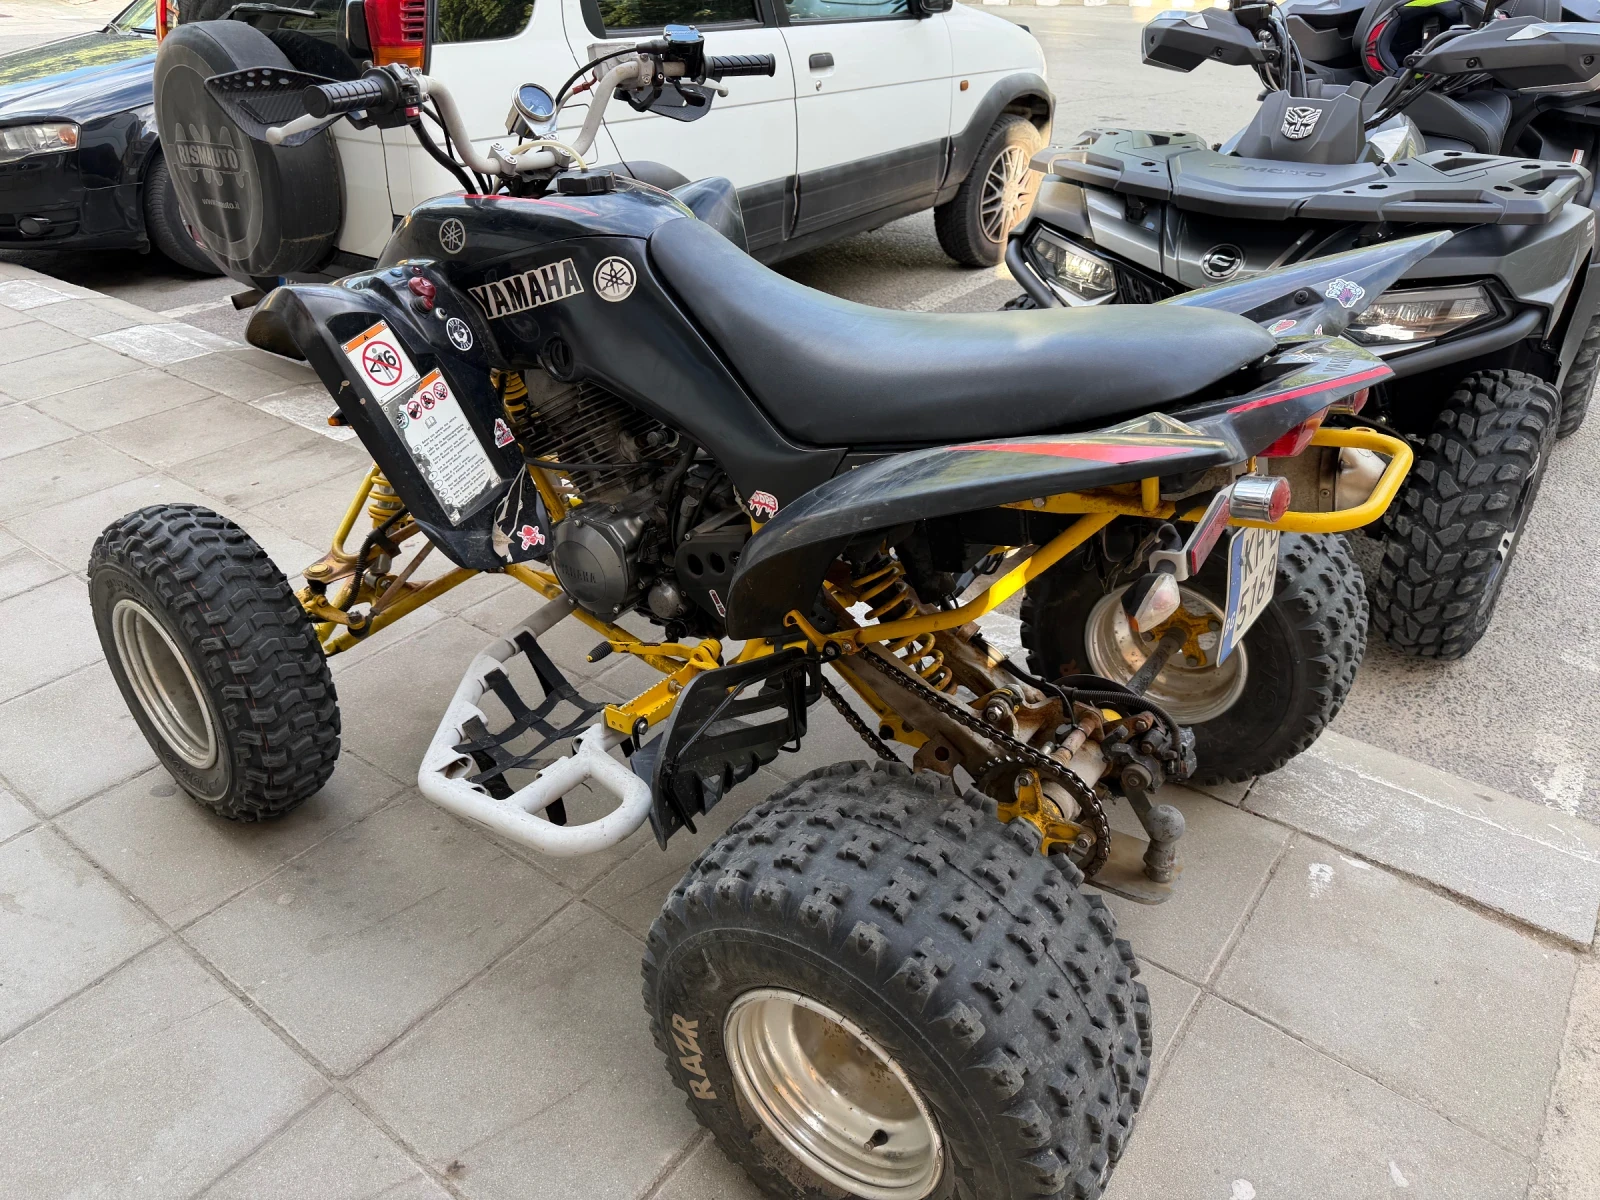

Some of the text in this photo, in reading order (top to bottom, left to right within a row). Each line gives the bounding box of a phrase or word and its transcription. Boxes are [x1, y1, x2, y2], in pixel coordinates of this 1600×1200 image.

[177, 144, 239, 168] RISMAUTO
[470, 260, 582, 317] YAMAHA
[1236, 553, 1276, 631] 5169
[1224, 611, 1236, 638] BG
[671, 1013, 717, 1099] RAZR
